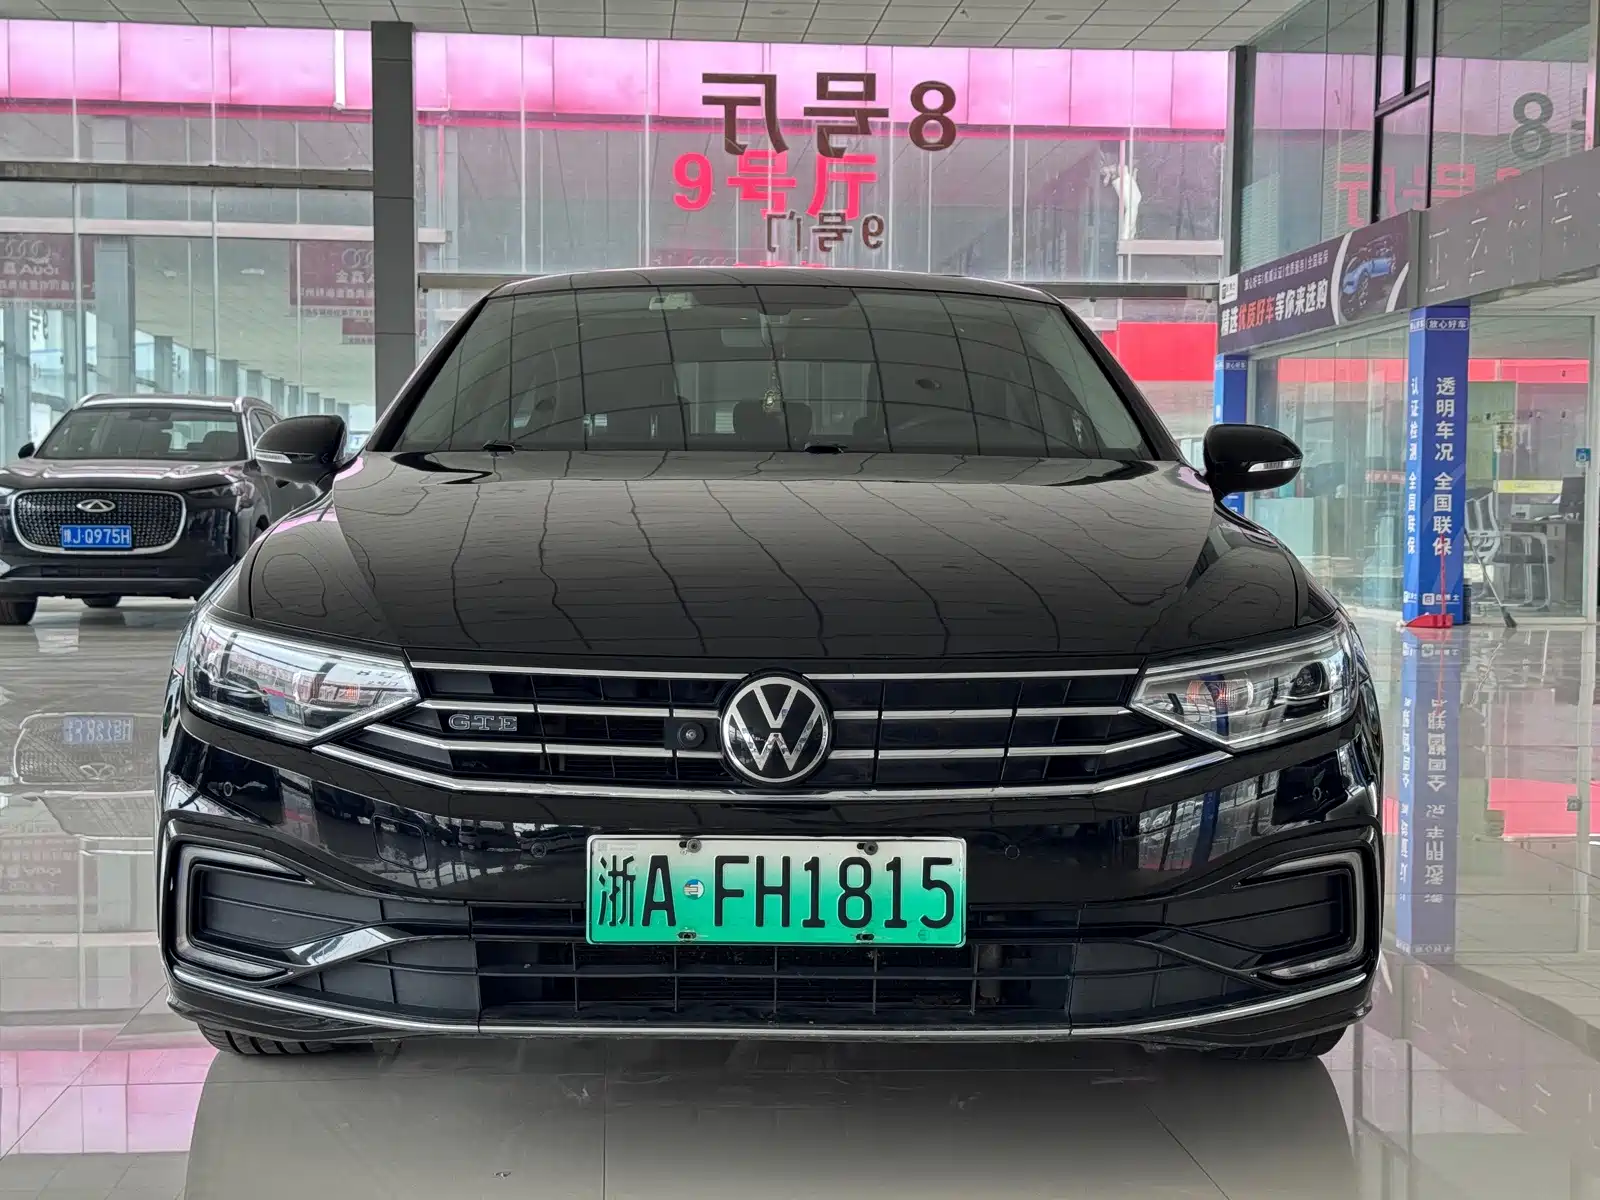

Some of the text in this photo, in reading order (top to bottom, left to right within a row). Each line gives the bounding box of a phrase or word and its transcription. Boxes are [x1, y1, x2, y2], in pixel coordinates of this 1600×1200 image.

[673, 149, 877, 220] 9号厅
[1428, 320, 1467, 328] 放心好车
[1432, 377, 1456, 556] 透明车况 全国联保
[447, 713, 518, 732] GTE
